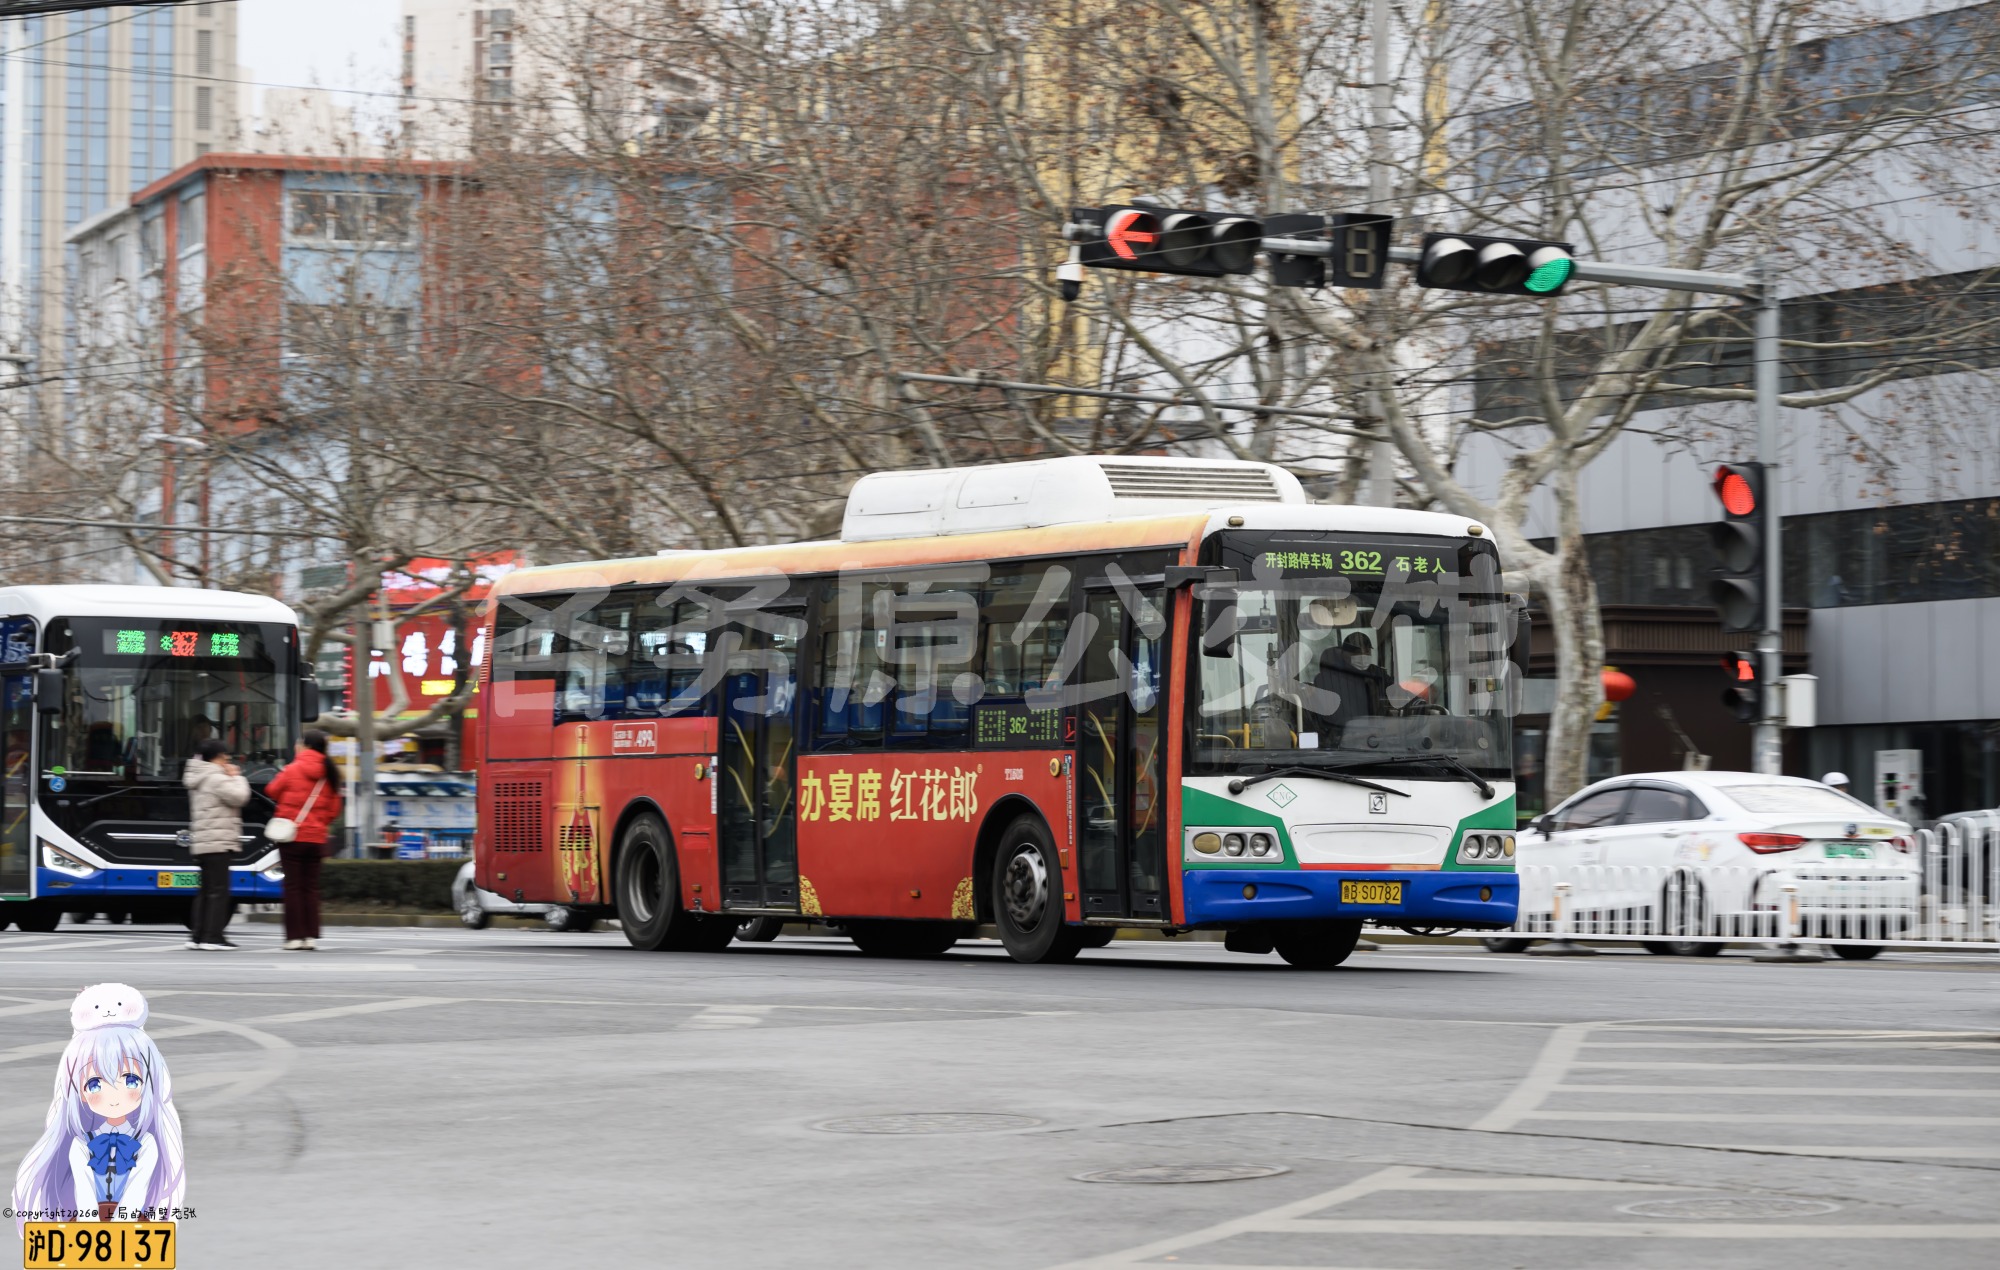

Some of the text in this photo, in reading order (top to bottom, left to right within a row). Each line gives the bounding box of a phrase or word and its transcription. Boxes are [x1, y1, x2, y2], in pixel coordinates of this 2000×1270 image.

[1265, 550, 1447, 574] 开封路停车场 362 石老人
[1009, 717, 1027, 734] 362
[800, 766, 979, 823] 办宴席 红花郎
[1272, 791, 1291, 801] CNG
[1344, 885, 1400, 901] 鲁B·S0782
